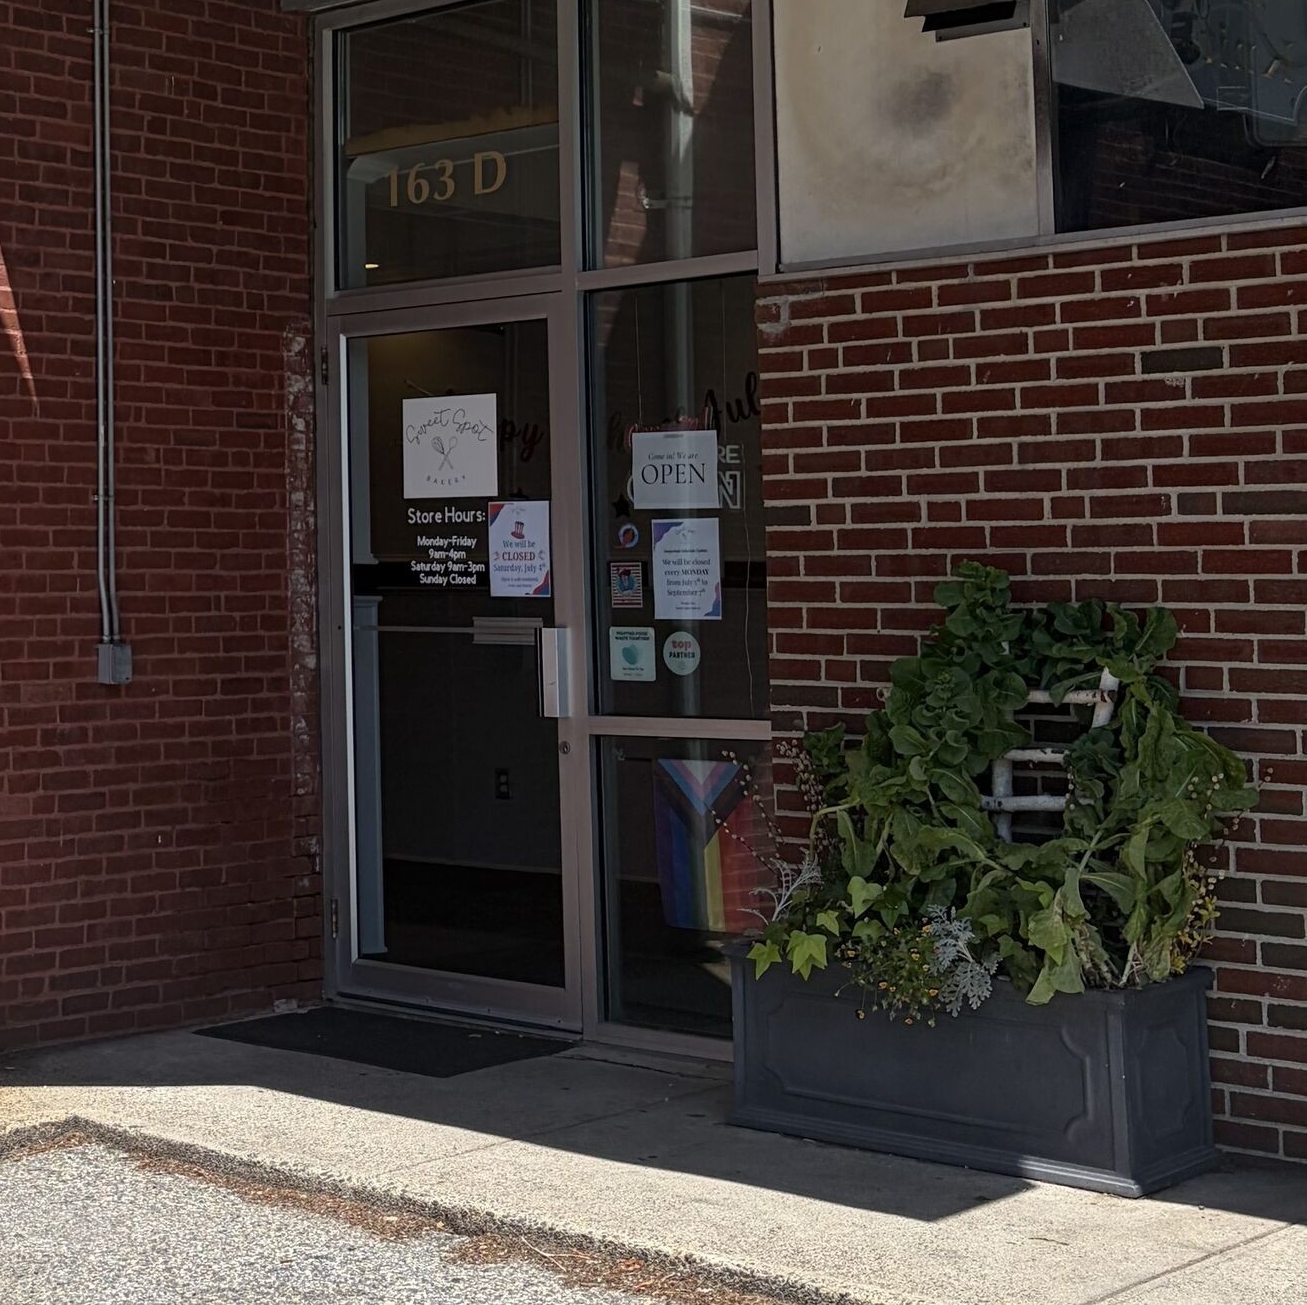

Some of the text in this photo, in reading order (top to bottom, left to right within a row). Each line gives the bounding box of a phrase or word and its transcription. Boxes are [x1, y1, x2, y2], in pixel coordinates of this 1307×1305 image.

[384, 151, 507, 207] 163 D
[705, 371, 761, 438] Jul
[405, 408, 494, 445] Sweet Spot
[641, 463, 706, 485] OPEN
[407, 506, 486, 524] Store Hours:
[416, 535, 477, 549] Monday-Friday
[502, 540, 536, 548] We will be
[428, 548, 466, 560] 9am-4pm
[502, 551, 536, 561] CLOSED
[410, 560, 485, 573] Saturday 9am-3pm
[524, 564, 537, 573] July
[692, 558, 711, 566] closed
[419, 574, 477, 587] Sunday Closed
[667, 589, 698, 597] September
[671, 640, 692, 651] top
